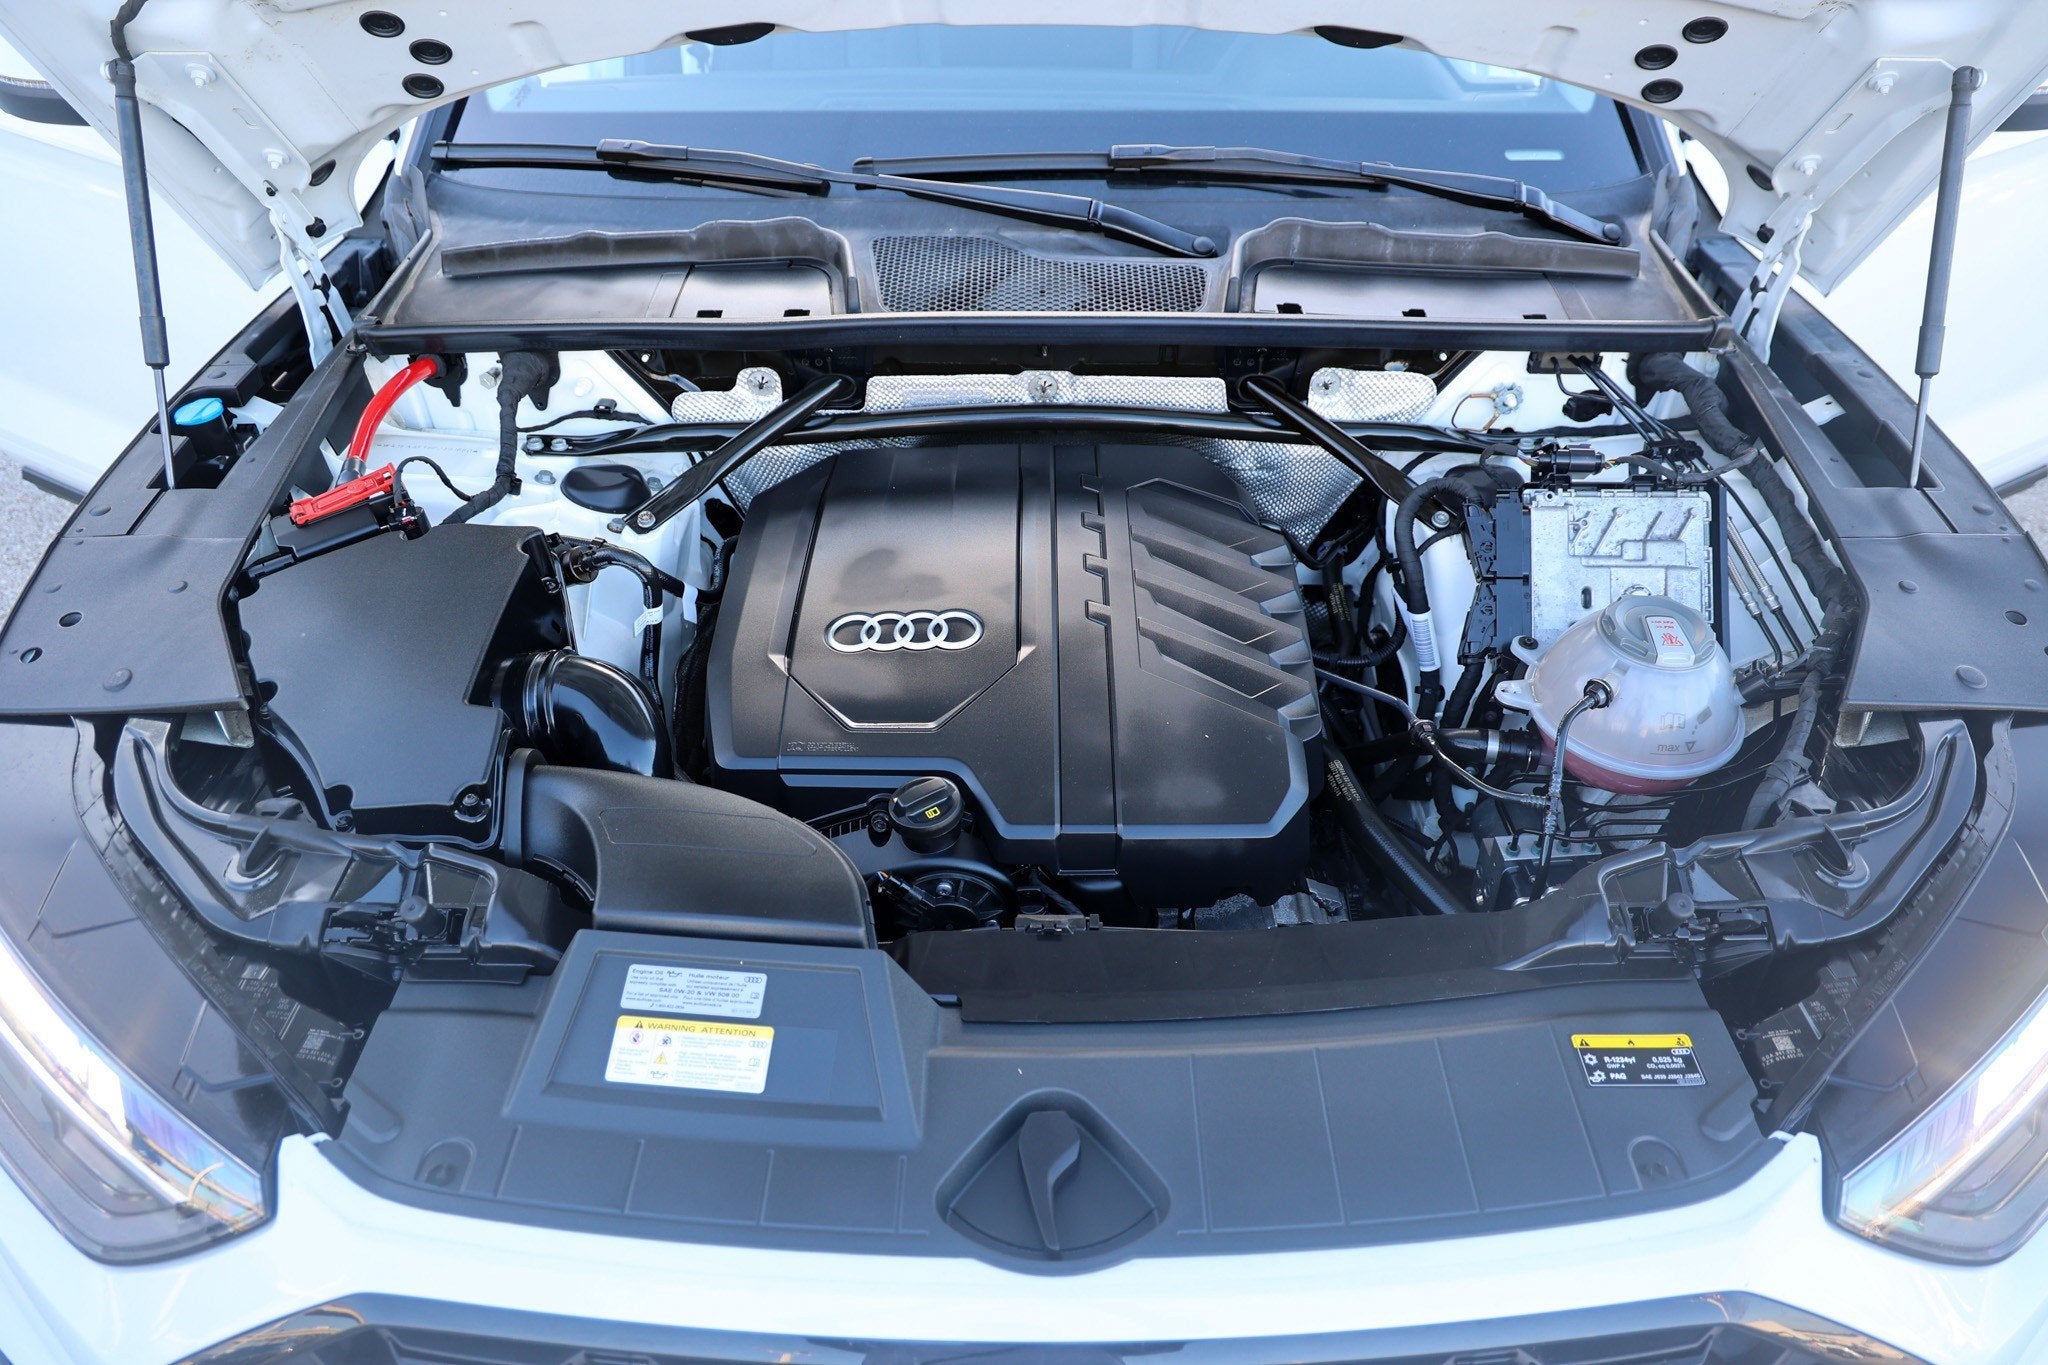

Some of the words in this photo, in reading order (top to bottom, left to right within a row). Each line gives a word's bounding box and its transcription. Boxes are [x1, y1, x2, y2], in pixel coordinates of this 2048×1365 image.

[1657, 744, 1680, 752] max
[647, 1023, 696, 1033] WARNING
[701, 1026, 757, 1037] ATTENTION
[1603, 1056, 1636, 1064] R-1234yf
[1673, 1056, 1683, 1064] kg
